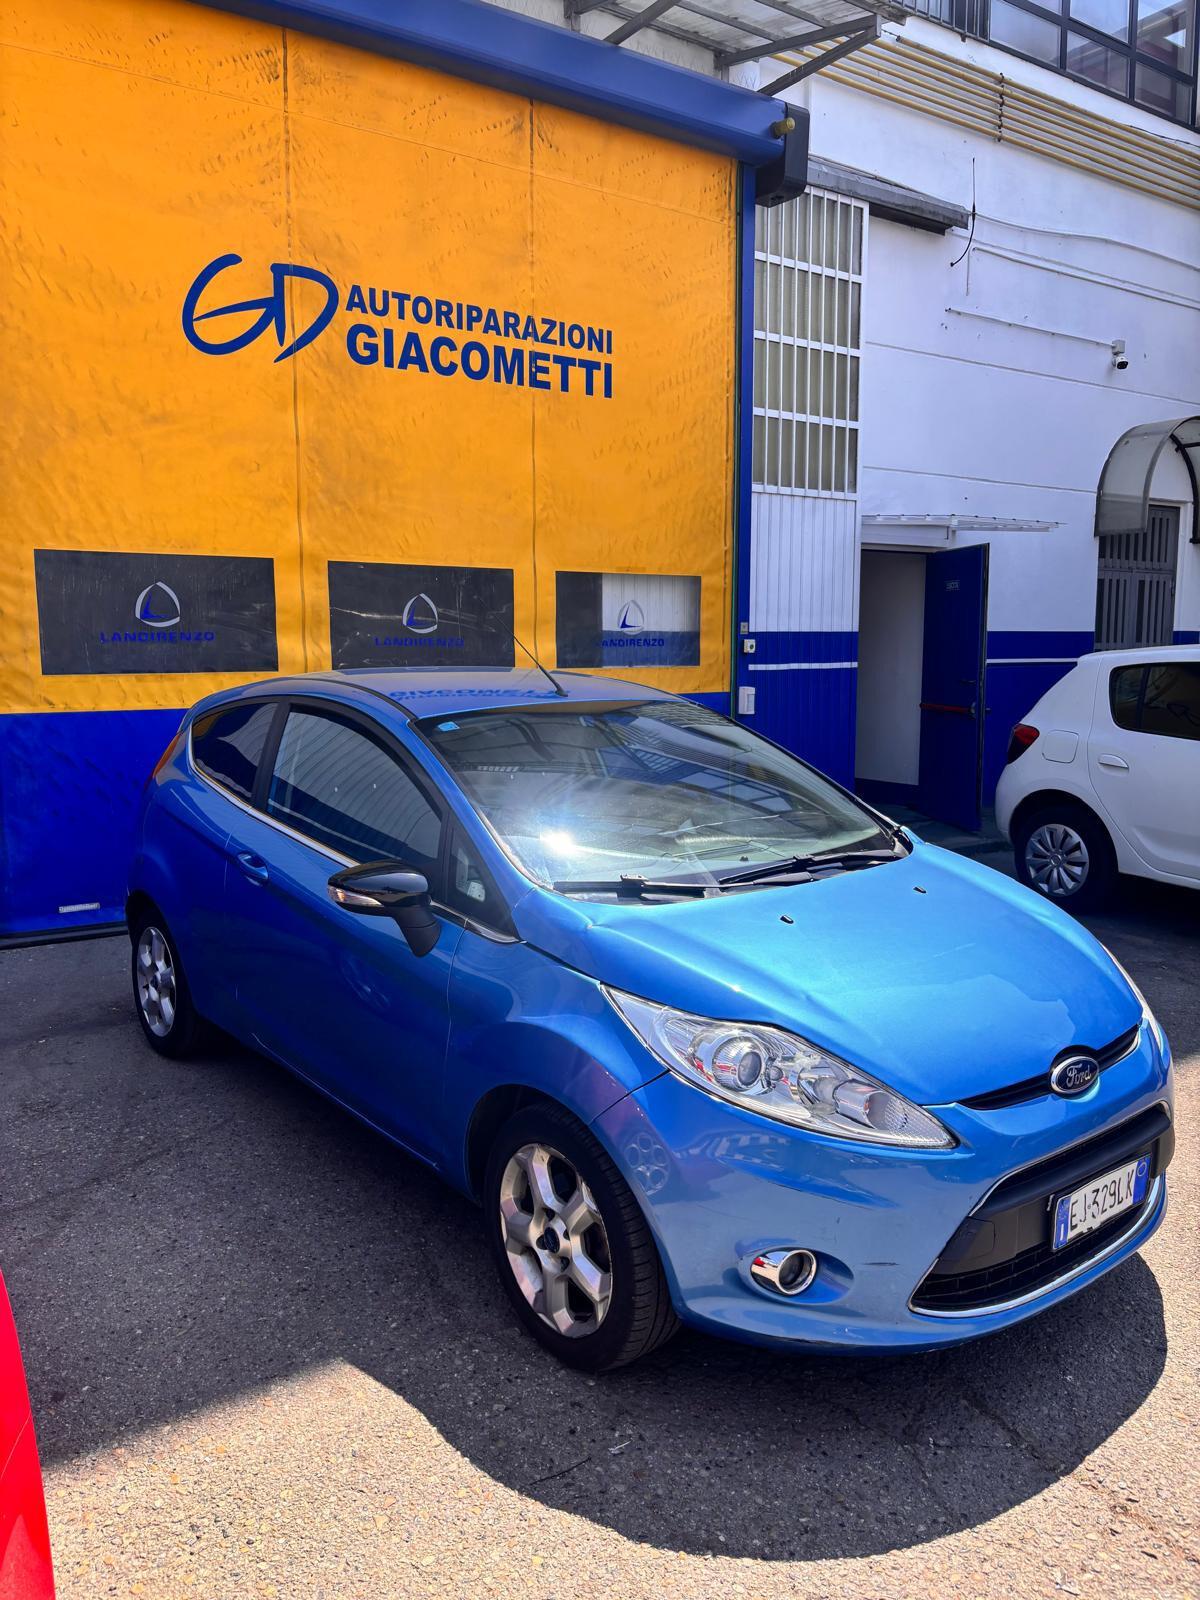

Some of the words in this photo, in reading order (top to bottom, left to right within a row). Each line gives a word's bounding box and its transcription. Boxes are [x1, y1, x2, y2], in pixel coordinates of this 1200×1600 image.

[346, 285, 613, 354] AUTORIPARAZIONI
[346, 325, 613, 398] GIACOMETTI
[1066, 1063, 1091, 1087] Ford
